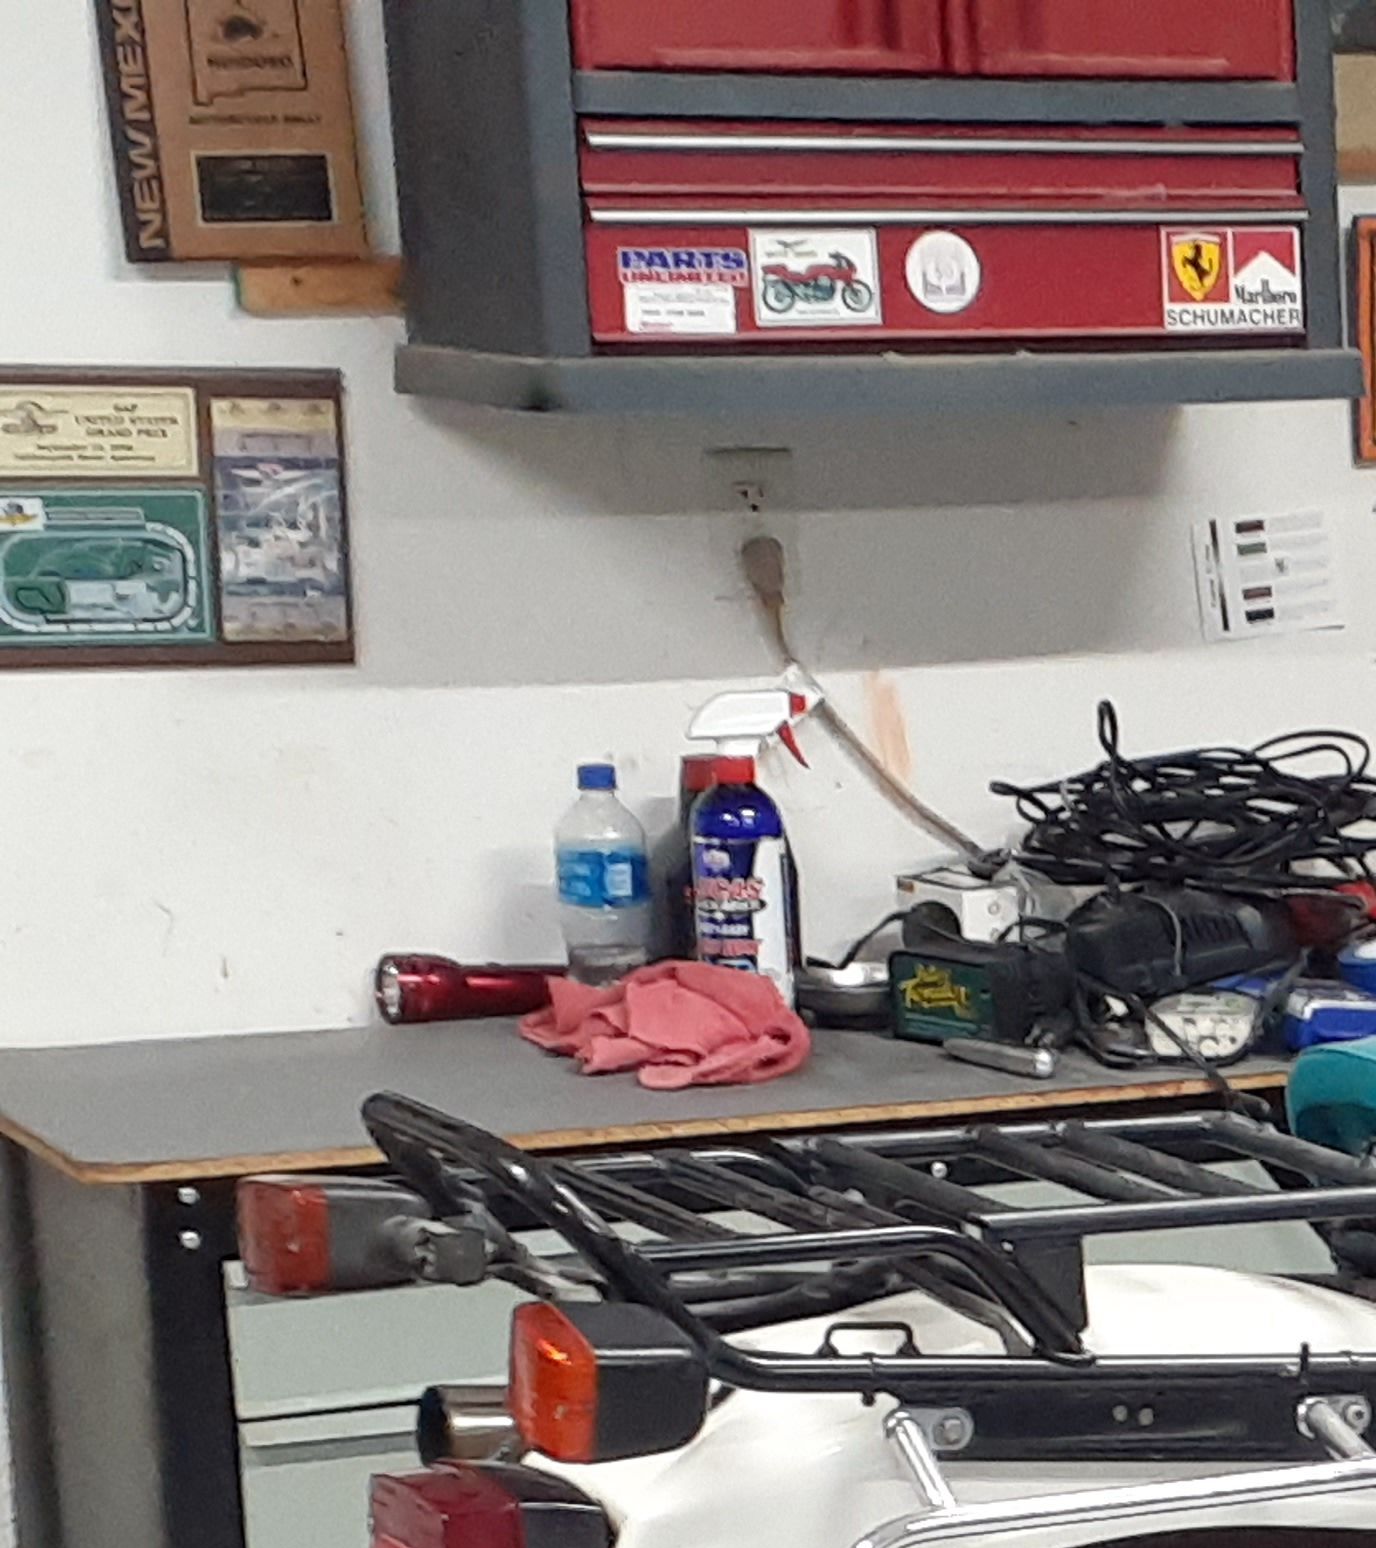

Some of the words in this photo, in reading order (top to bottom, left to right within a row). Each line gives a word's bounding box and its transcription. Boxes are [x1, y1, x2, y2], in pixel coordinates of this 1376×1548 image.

[125, 125, 166, 249] NEW
[621, 249, 745, 270] PARTS
[1166, 308, 1301, 326] SCHUMACHER
